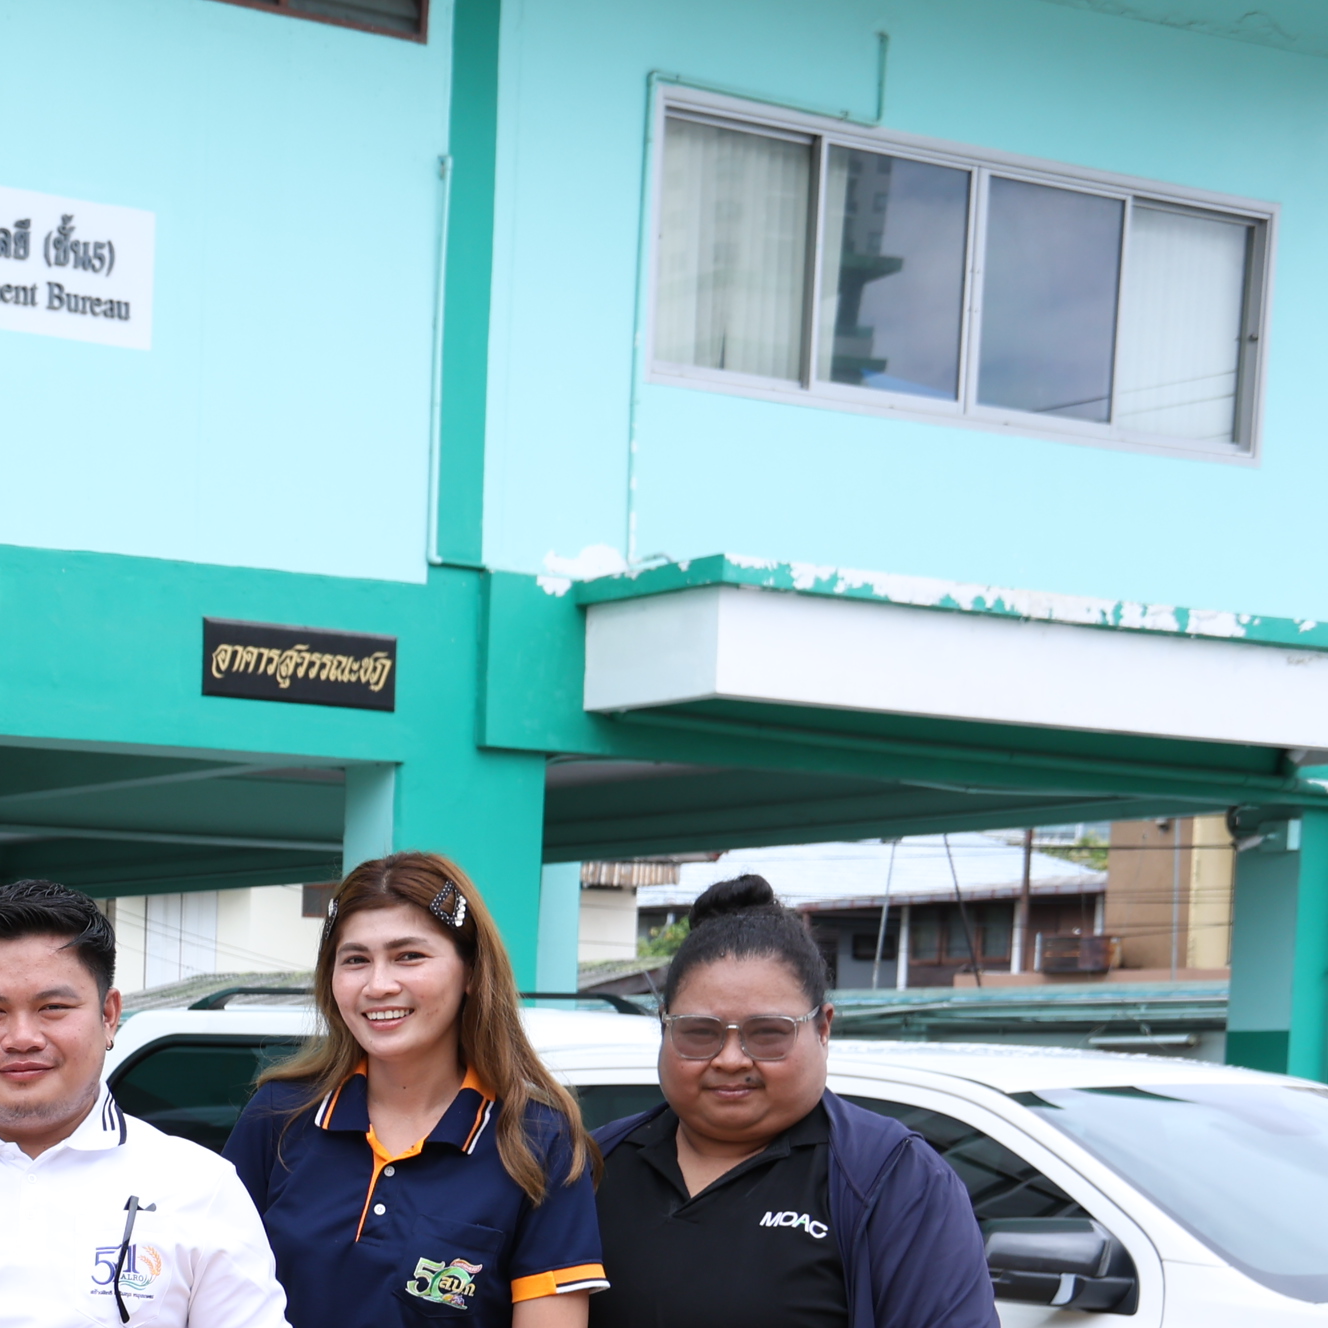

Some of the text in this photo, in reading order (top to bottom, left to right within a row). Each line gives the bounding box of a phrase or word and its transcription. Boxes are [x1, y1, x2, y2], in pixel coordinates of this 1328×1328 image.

[46, 281, 131, 321] Bureau
[759, 1211, 828, 1239] MOAC
[120, 1273, 145, 1282] ALRO
